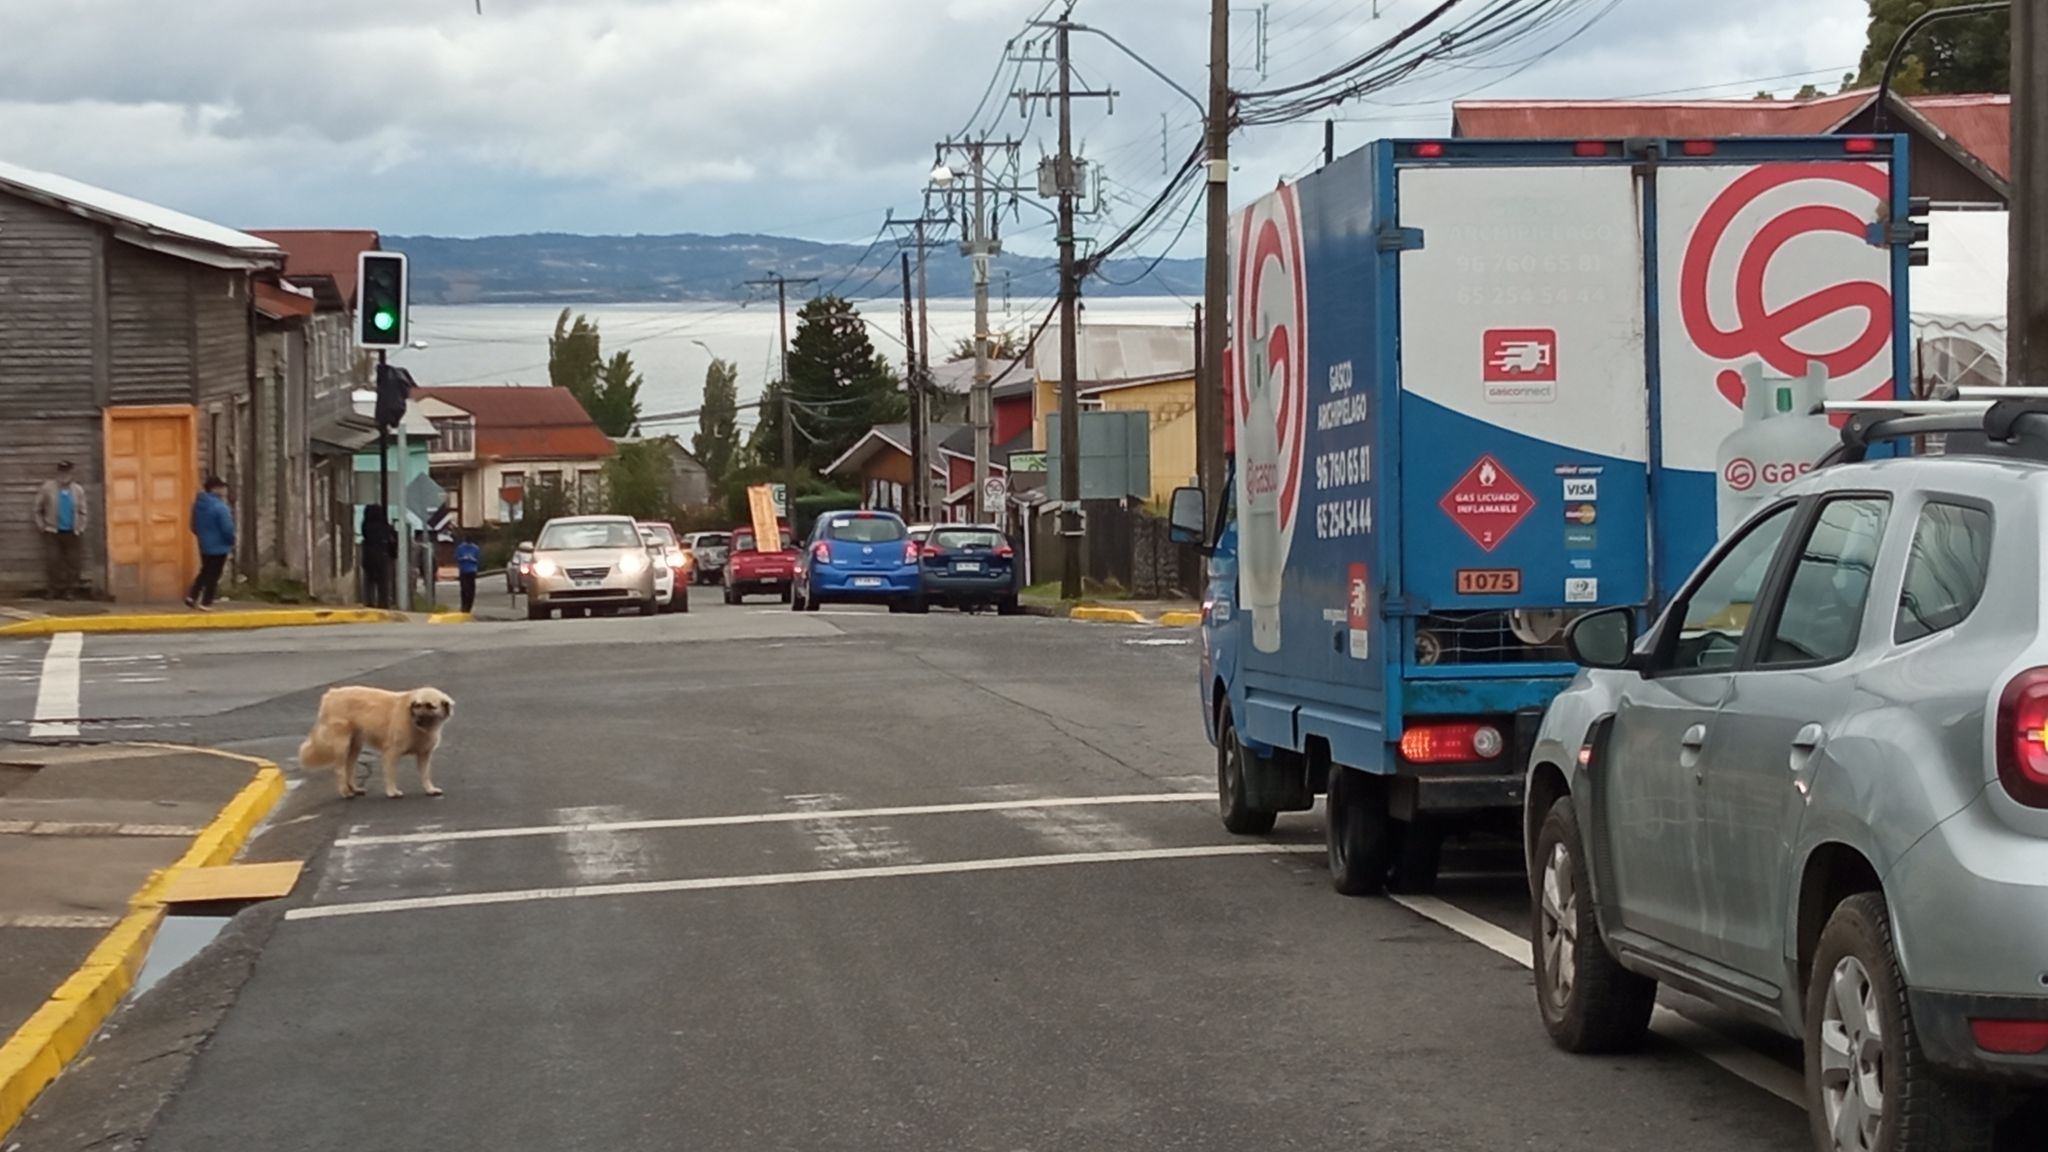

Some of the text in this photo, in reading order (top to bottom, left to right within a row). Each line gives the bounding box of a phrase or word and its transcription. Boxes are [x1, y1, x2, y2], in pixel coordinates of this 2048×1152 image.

[1329, 360, 1352, 393] GASCO
[1316, 454, 1328, 490] 96
[1329, 450, 1346, 488] 760
[1347, 447, 1358, 485] 65
[1567, 484, 1594, 496] VISA
[1455, 493, 1520, 502] GAS LICUADO
[1456, 504, 1518, 514] INFLAMABLE
[1316, 497, 1372, 539] 65 254 54 44
[1483, 531, 1492, 543] 2
[1463, 573, 1514, 590] 1075
